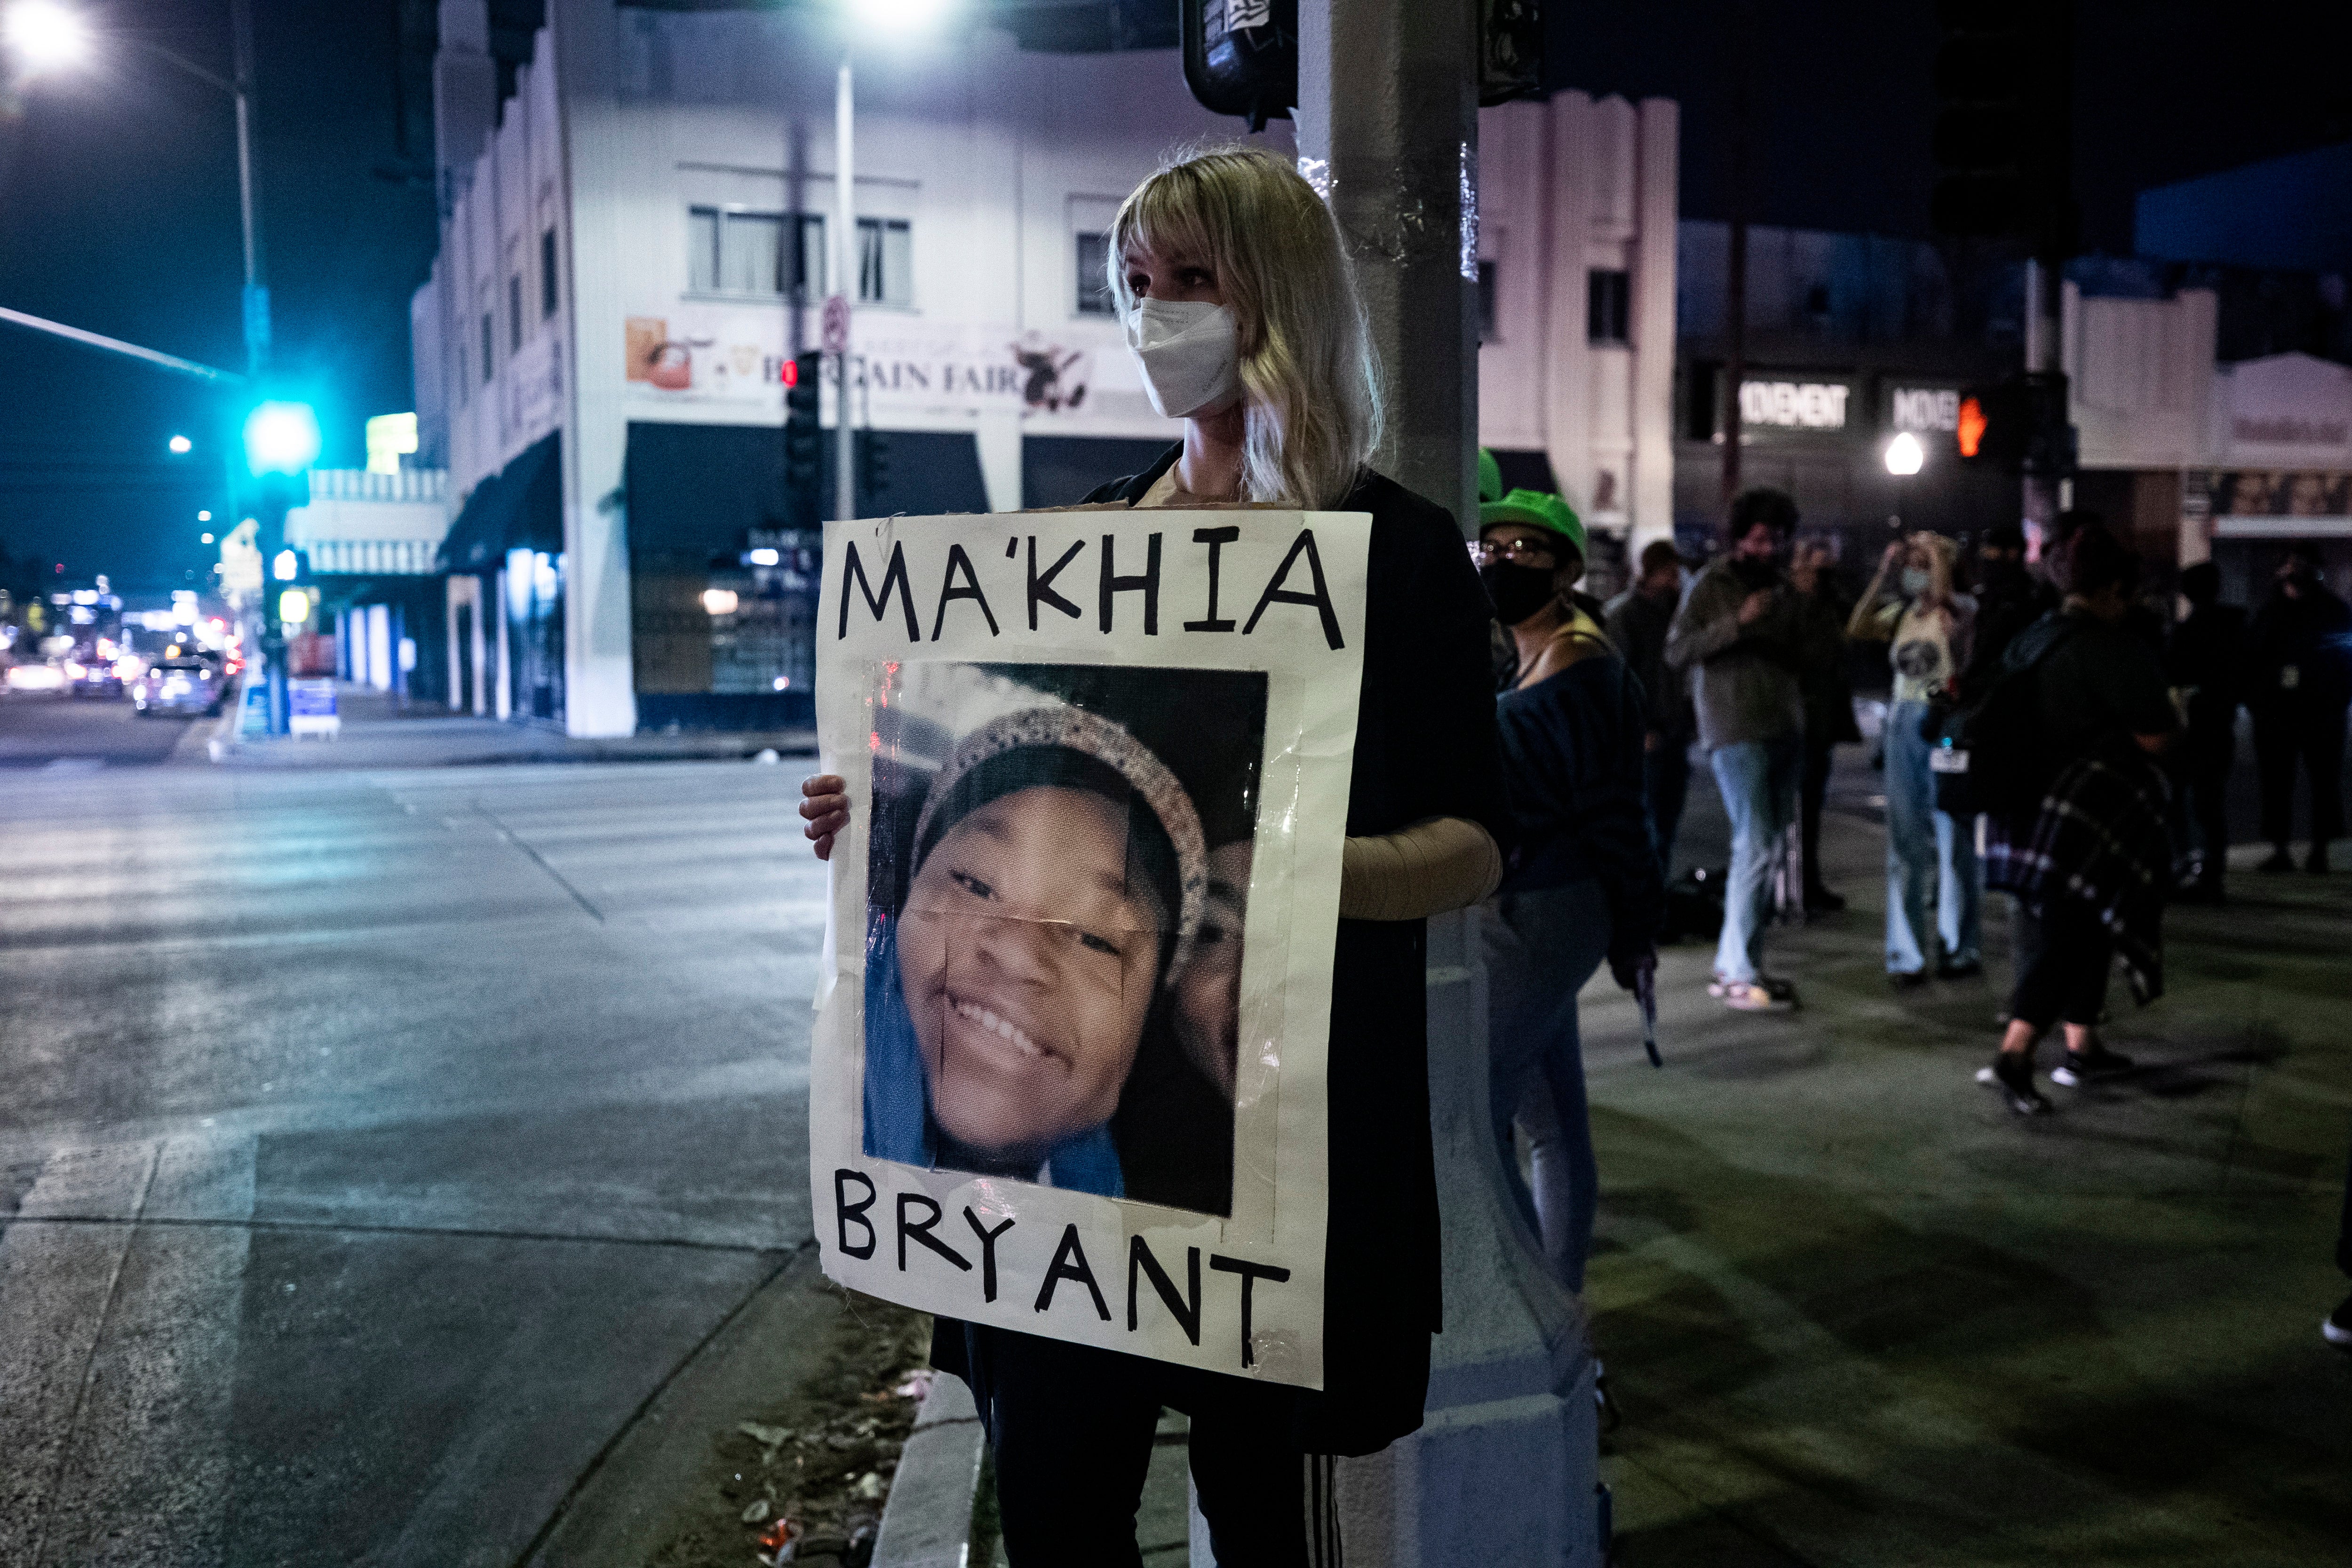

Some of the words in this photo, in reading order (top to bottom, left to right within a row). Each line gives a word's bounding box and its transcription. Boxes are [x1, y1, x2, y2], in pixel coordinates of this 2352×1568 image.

[943, 363, 1023, 394] FAIR
[1740, 382, 1848, 427] OVEMENT
[838, 525, 1345, 651] MA'KHIA
[834, 1169, 1291, 1369] BRYANT
